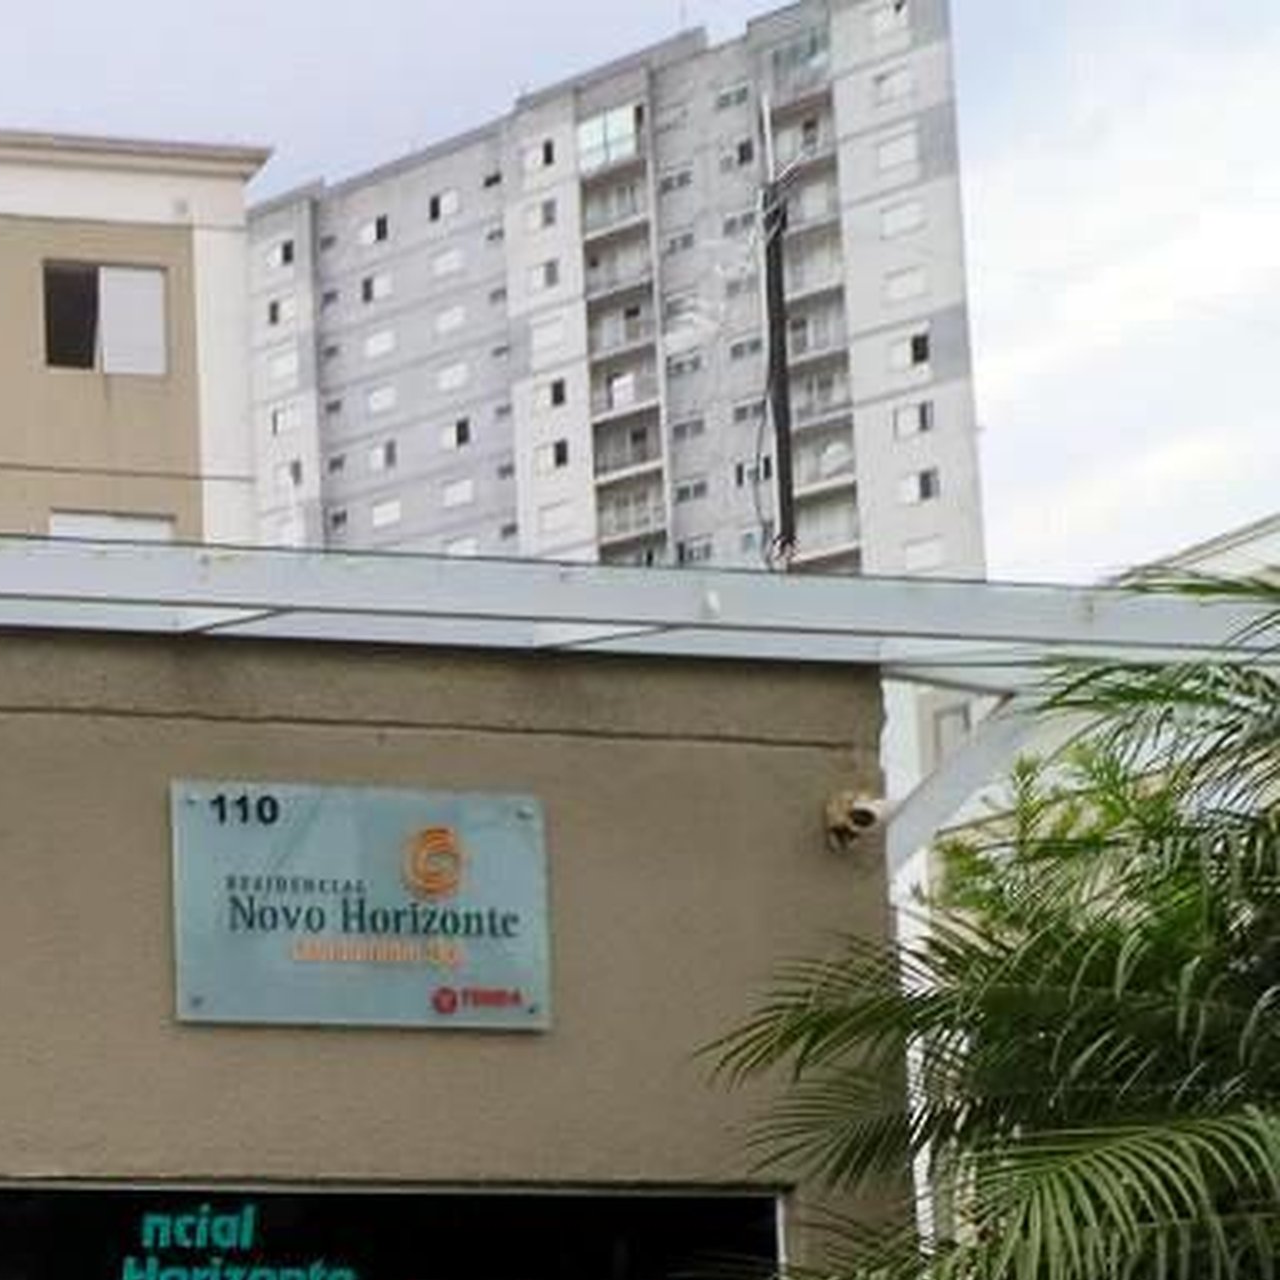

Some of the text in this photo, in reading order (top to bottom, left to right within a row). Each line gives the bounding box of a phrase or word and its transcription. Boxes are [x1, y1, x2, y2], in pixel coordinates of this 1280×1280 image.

[209, 793, 280, 826] 110
[225, 875, 368, 895] RESIDENCIAL
[229, 895, 520, 939] Novo Horizonte
[141, 1202, 257, 1250] ncial
